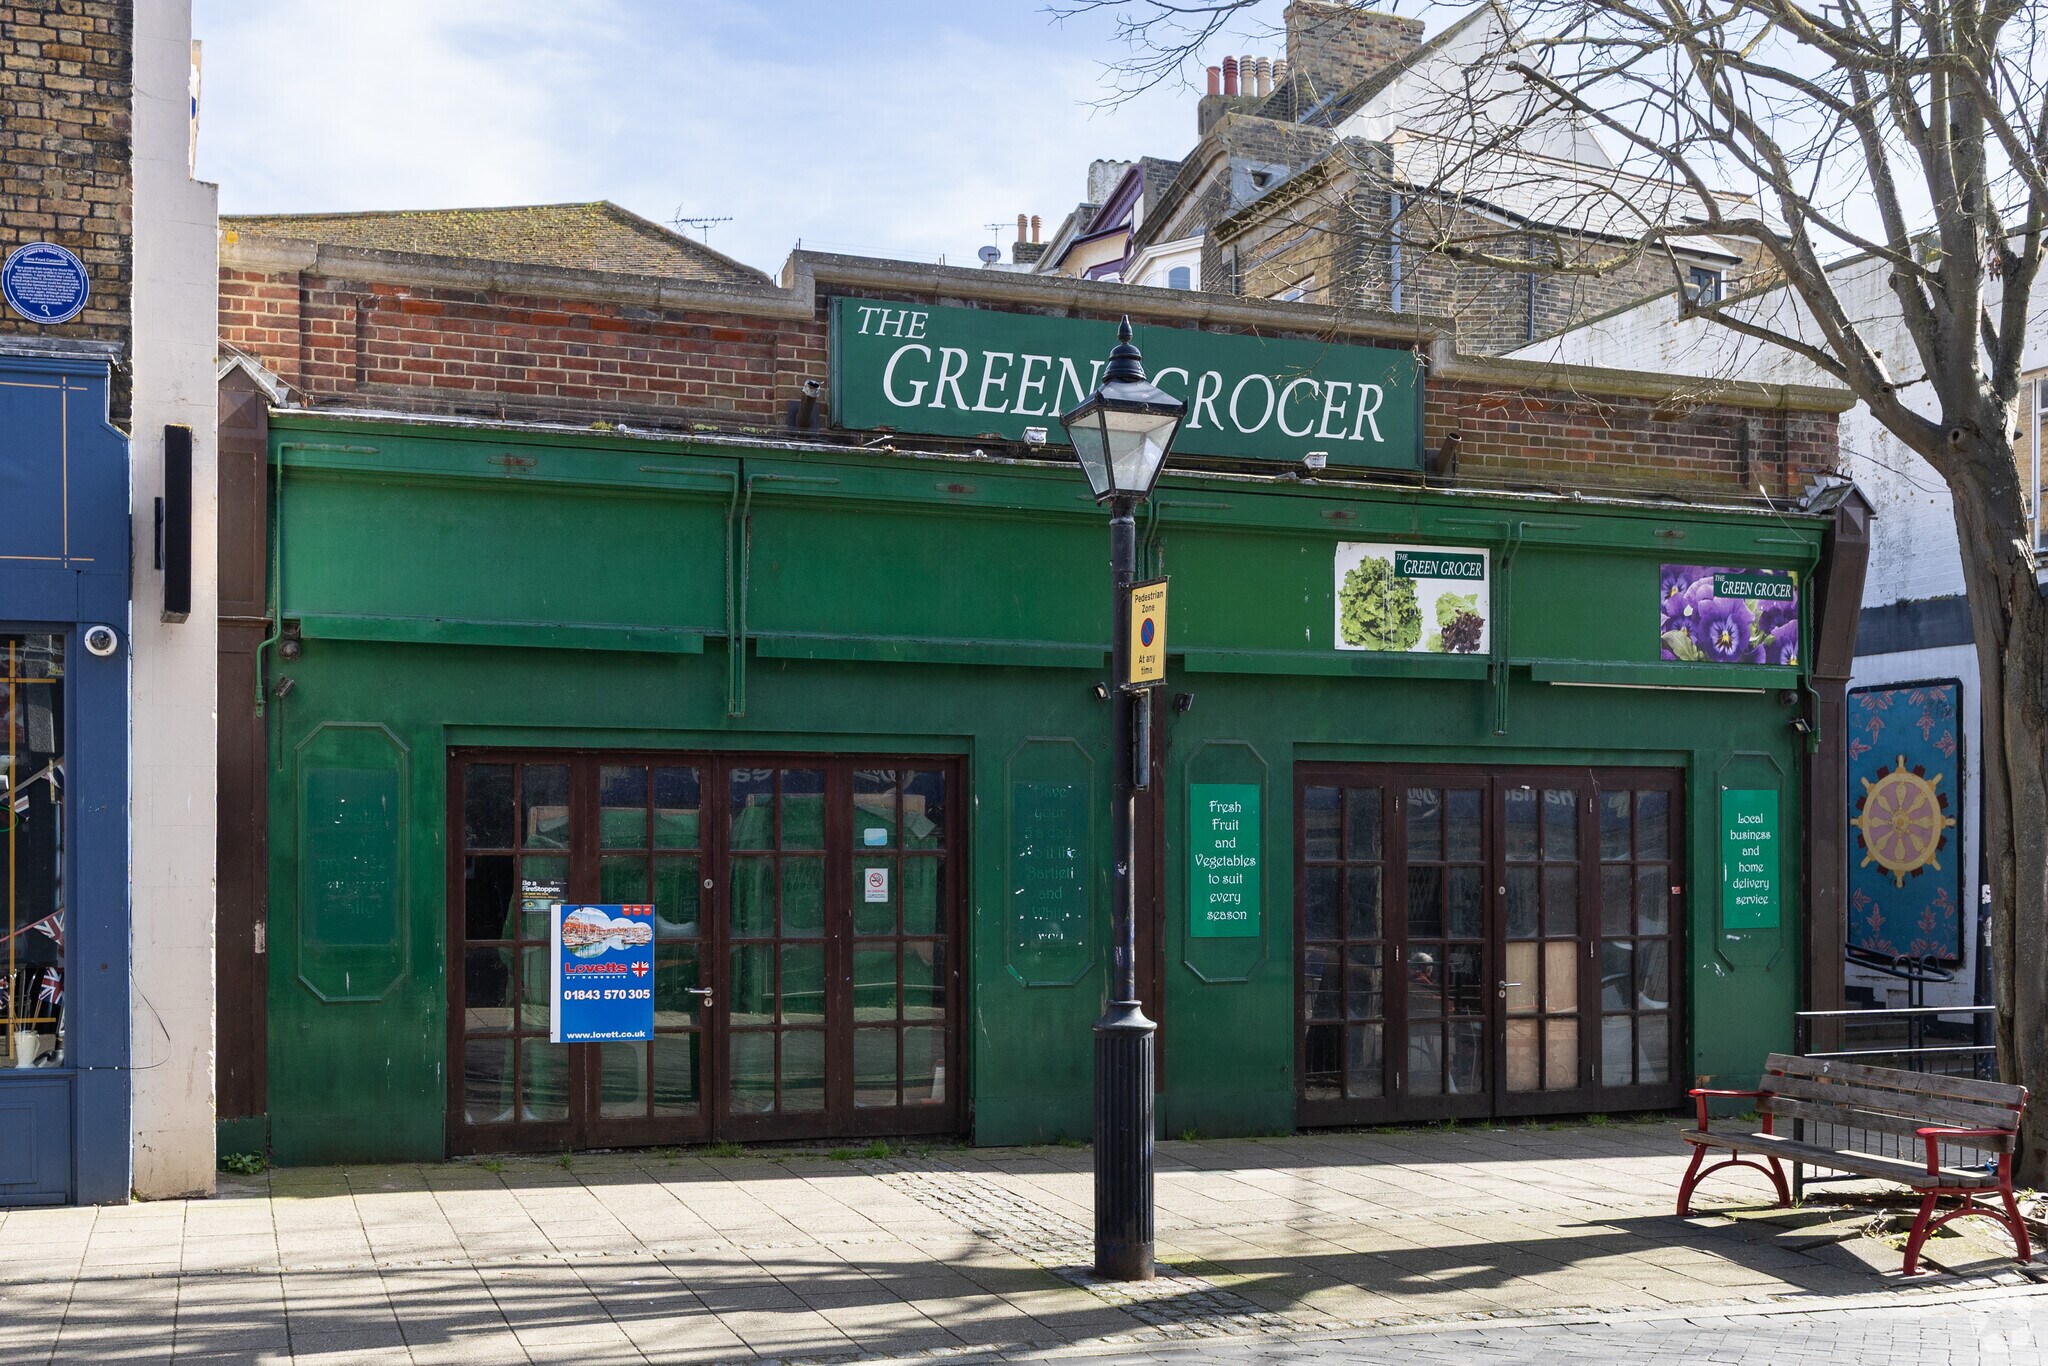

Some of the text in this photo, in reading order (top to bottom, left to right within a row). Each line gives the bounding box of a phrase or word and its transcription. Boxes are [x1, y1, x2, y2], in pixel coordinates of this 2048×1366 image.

[858, 306, 928, 339] THE
[882, 344, 1104, 417] GREEN
[1404, 560, 1482, 576] GREEN GROCER
[1721, 581, 1791, 597] GREEN GROCER
[1135, 590, 1163, 603] Pedestrian
[1142, 604, 1155, 613] Zone
[1139, 655, 1155, 664] At any
[1141, 666, 1152, 675] time
[1209, 800, 1242, 814] Fresh
[1737, 813, 1763, 824] Local
[1212, 818, 1239, 831] Fruit
[1730, 830, 1771, 840] business
[1215, 837, 1236, 848] and
[1742, 846, 1759, 856] and
[1195, 854, 1256, 869] Vegetables
[1738, 862, 1764, 872] home
[1208, 873, 1243, 884] to suit
[1733, 878, 1769, 890] delivery
[1210, 892, 1240, 905] every
[1735, 895, 1768, 905] service
[1207, 911, 1247, 921] season
[565, 962, 627, 973] Lovetts
[564, 990, 650, 1000] 01843 570 305
[567, 1030, 646, 1039] www.lovett.co.uk
